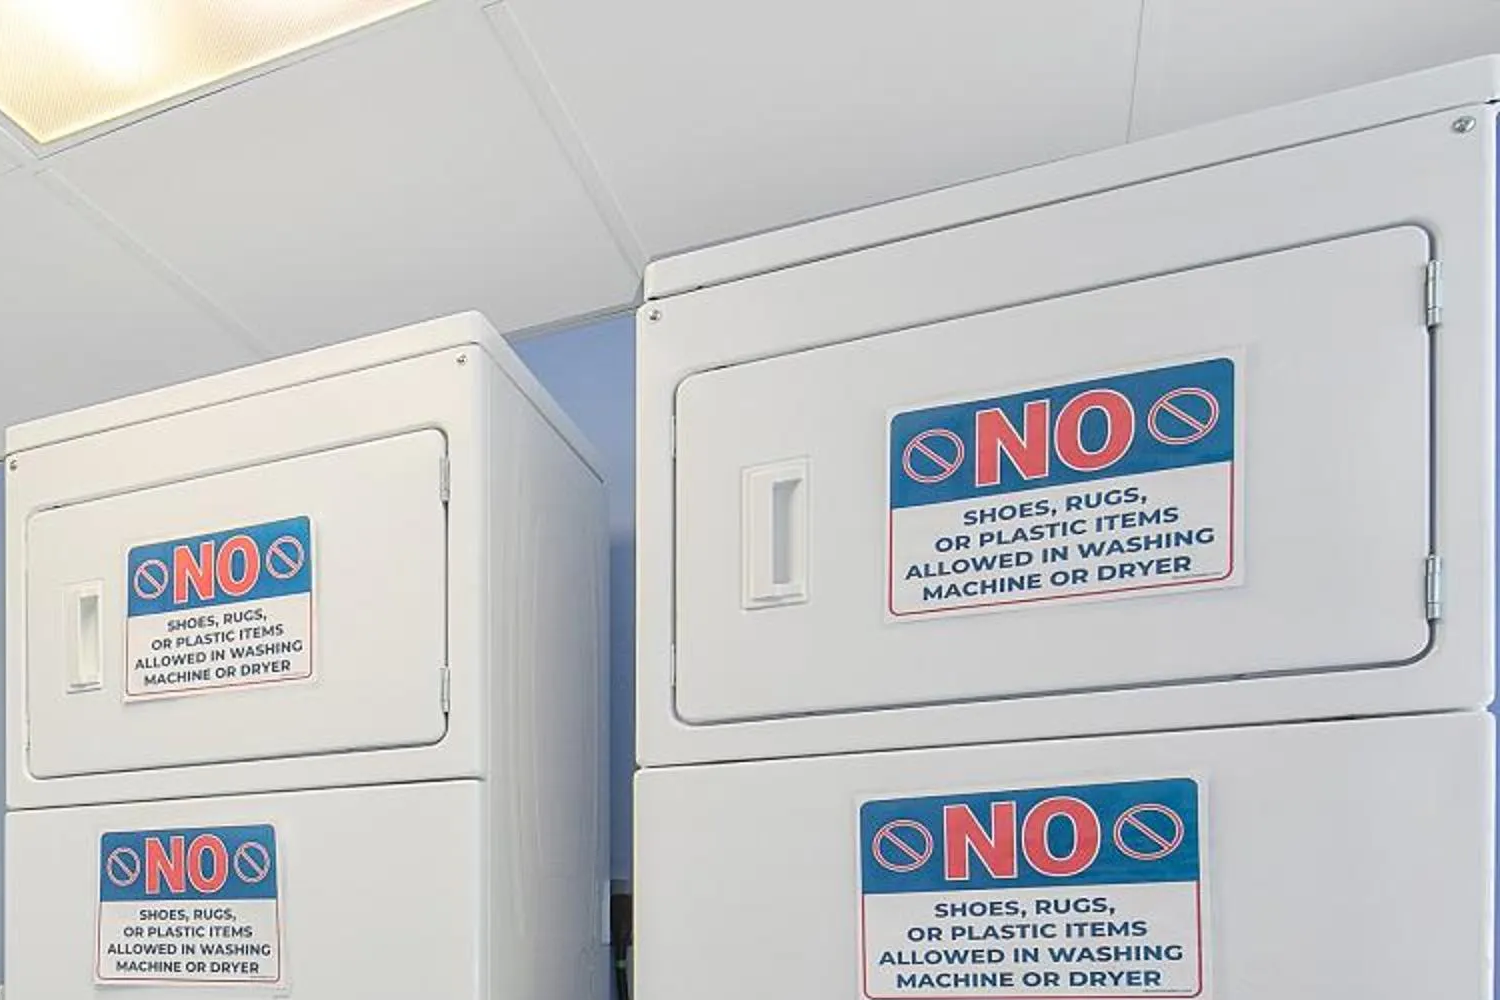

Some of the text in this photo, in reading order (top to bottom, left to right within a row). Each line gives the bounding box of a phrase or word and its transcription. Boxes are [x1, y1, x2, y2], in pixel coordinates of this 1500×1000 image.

[975, 388, 1136, 488] NO
[963, 486, 1148, 526] SHOES, RUGS,
[935, 506, 1179, 553] OR PLASTIC ITEMS
[905, 527, 1215, 580] ALLOWED IN WASHING
[174, 535, 261, 605] NO
[923, 555, 1191, 602] MACHINE OR DRYER
[167, 608, 267, 632] SHOES, RUGS,
[151, 624, 283, 651] OR PLASTIC ITEMS
[135, 640, 302, 670] ALLOWED IN WASHING
[144, 659, 291, 686] MACHINE OR DRYER
[944, 796, 1102, 881] NO
[145, 833, 229, 895] NO
[139, 908, 237, 922] SHOES, RUGS,
[935, 897, 1116, 919] SHOES, RUGS,
[123, 926, 253, 938] OR PLASTIC ITEMS
[907, 921, 1147, 942] OR PLASTIC ITEMS
[107, 943, 271, 956] ALLOWED IN WASHING
[880, 945, 1184, 966] ALLOWED IN WASHING
[116, 961, 259, 974] MACHINE OR DRYER
[897, 970, 1162, 989] MACHINE OR DRYER
